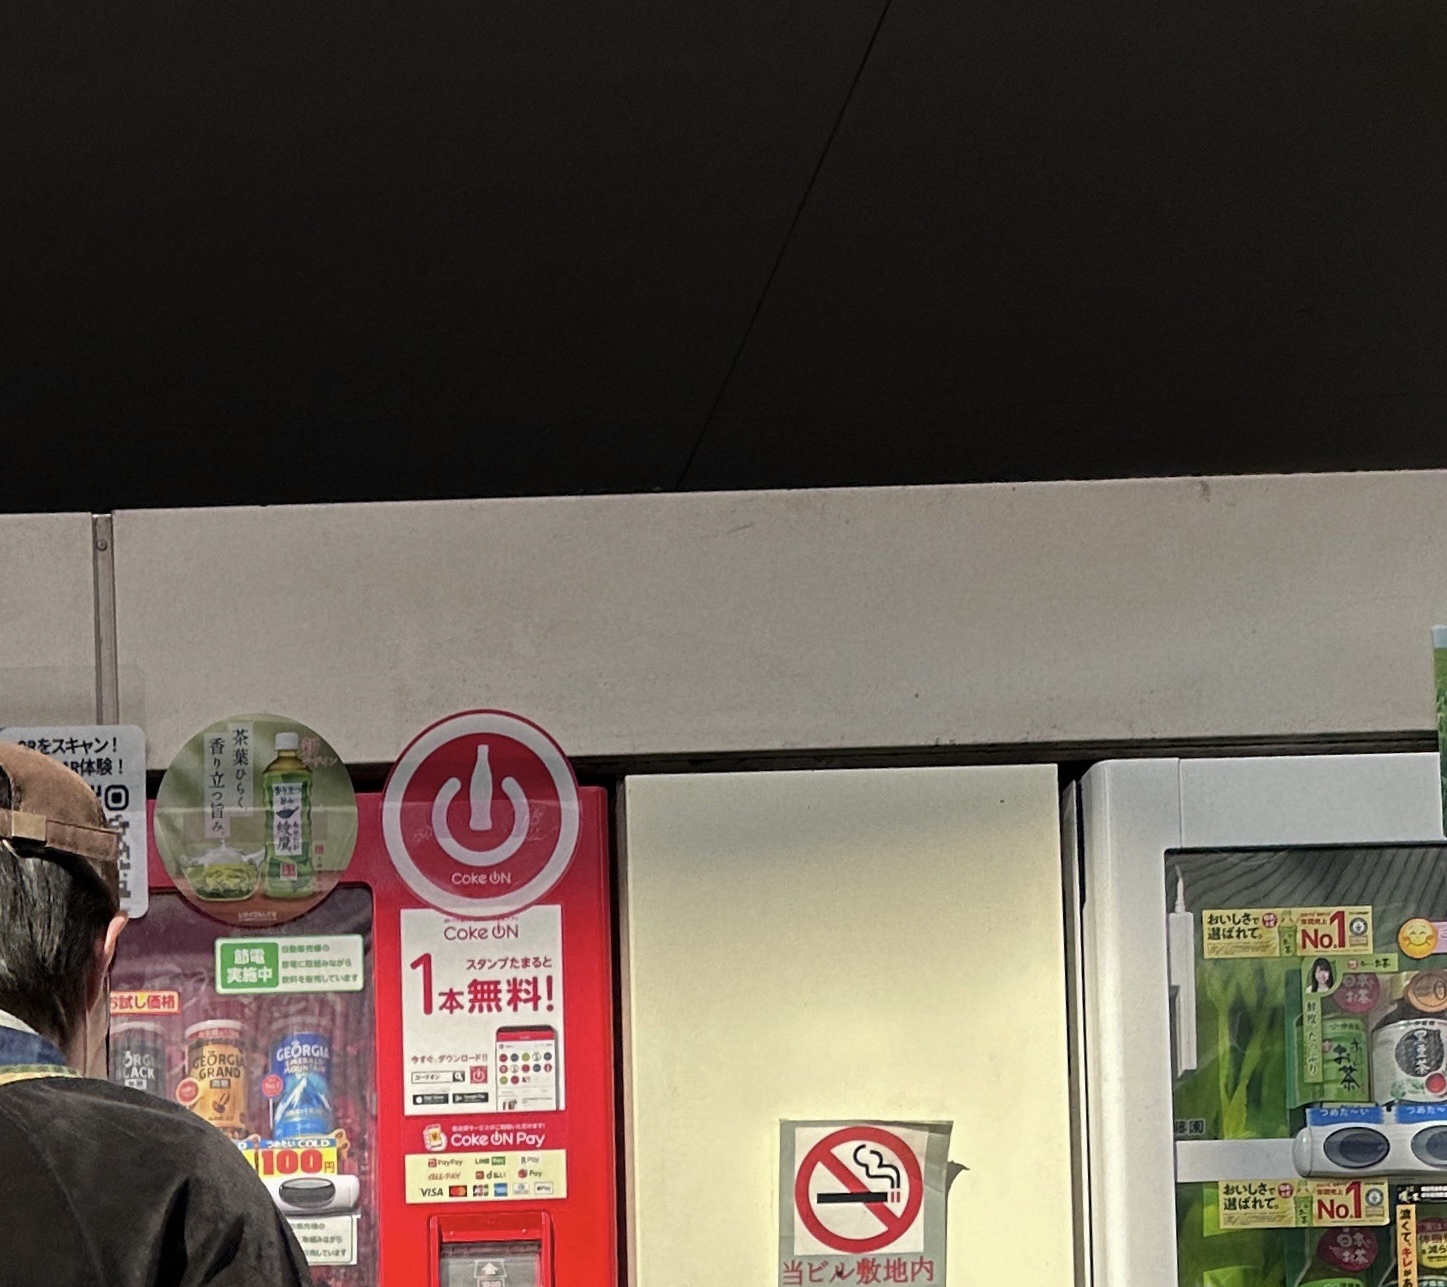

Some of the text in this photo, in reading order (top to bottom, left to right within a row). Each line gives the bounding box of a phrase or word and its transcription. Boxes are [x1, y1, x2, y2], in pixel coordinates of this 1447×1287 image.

[452, 871, 512, 885] Coke ON
[1207, 912, 1259, 925] おいしさで
[444, 922, 519, 941] Coke ON
[1208, 926, 1262, 941] 選ばれて。
[1301, 911, 1346, 950] No.1
[466, 957, 553, 971] スタンプたまると
[227, 967, 273, 984] 実施中
[199, 1065, 241, 1080] GRAND
[298, 1138, 331, 1149] COLD
[451, 1130, 545, 1147] Coke ON Pay
[421, 1188, 444, 1197] VISA
[1224, 1183, 1275, 1196] おいしさで
[1224, 1197, 1279, 1210] 選ばれて。
[1317, 1181, 1361, 1220] No.1
[783, 1256, 934, 1286] 当ビル敷地内
